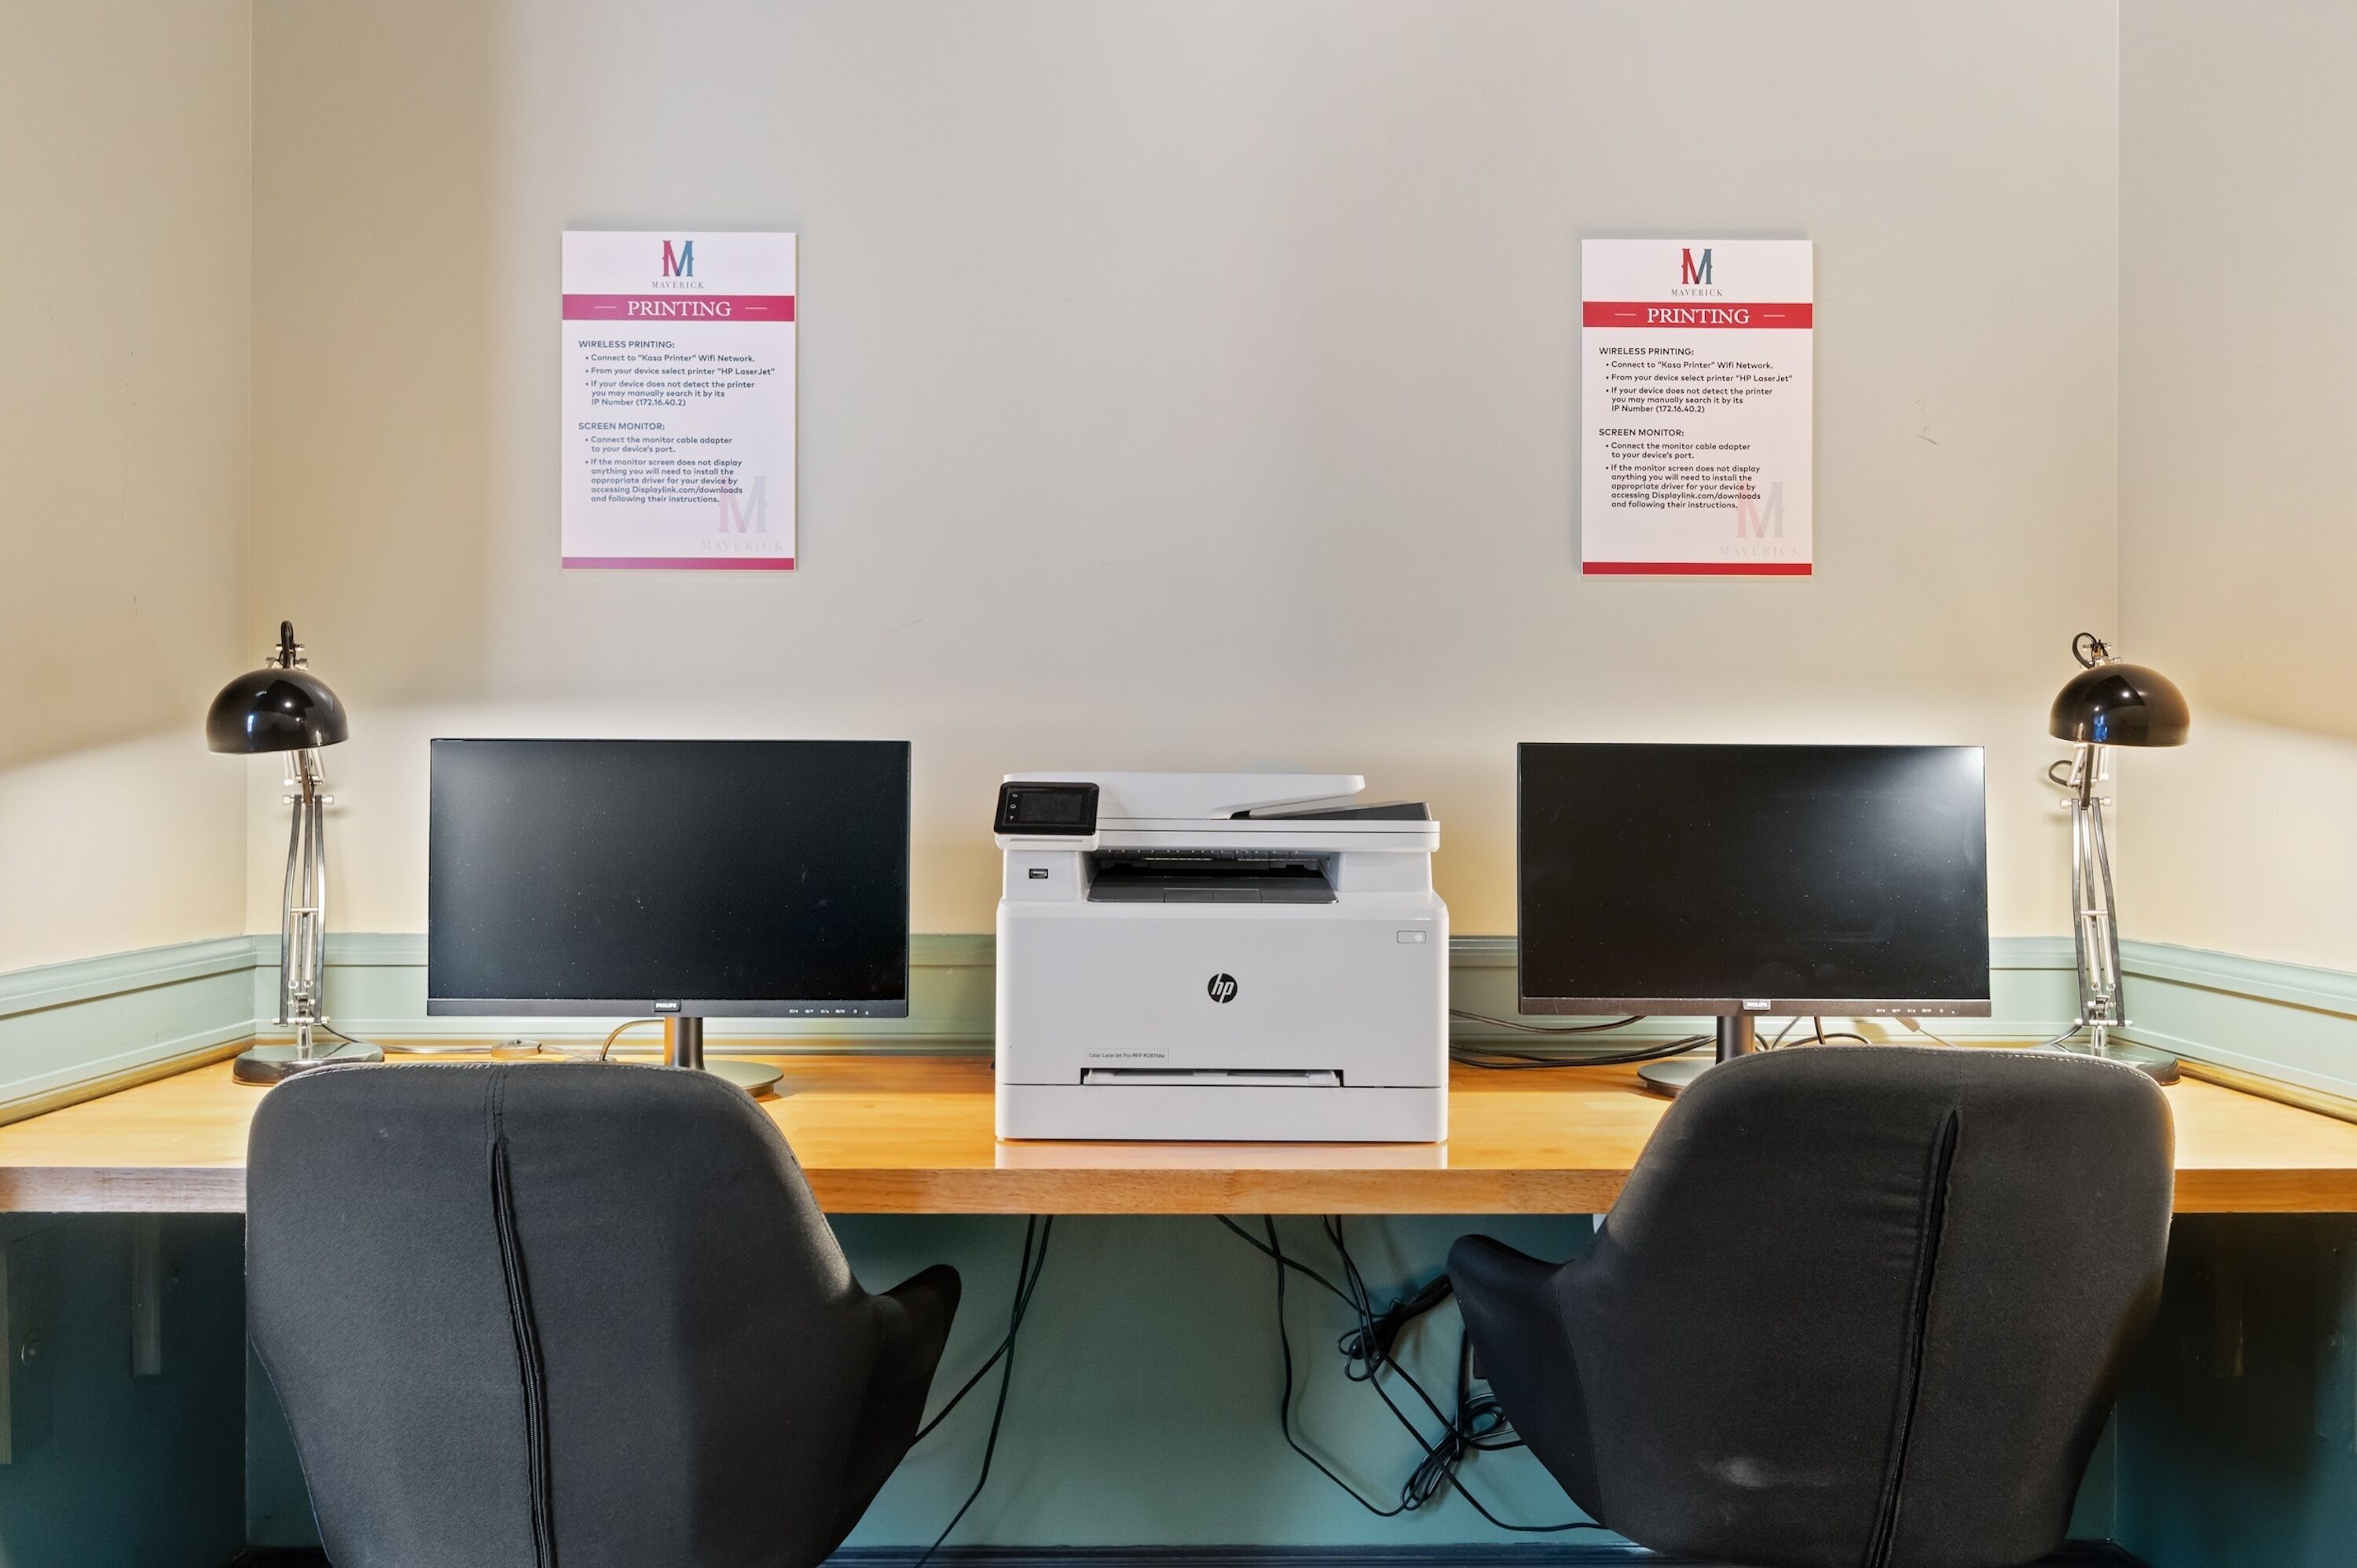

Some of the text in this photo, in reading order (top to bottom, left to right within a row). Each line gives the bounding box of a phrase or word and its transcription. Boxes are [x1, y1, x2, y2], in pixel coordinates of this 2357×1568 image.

[662, 240, 694, 277] M
[1681, 248, 1712, 284] M
[627, 301, 731, 317] PRINTING
[1647, 308, 1750, 324] PRINTING
[578, 340, 675, 349] WIRELESS PRINTING:
[1648, 347, 1694, 356] PRINTING:
[637, 354, 662, 362] "Kasa
[664, 354, 697, 362] Printer"
[698, 354, 716, 362] Wifi
[1683, 361, 1716, 369] Printer"
[591, 366, 613, 375] From
[661, 367, 686, 376] select
[687, 367, 716, 376] printer
[717, 367, 734, 376] "HP
[1653, 373, 1679, 382] device
[1706, 374, 1735, 383] printer
[618, 379, 644, 388] device
[646, 379, 665, 388] does
[727, 380, 755, 390] printer
[627, 389, 665, 398] manually
[665, 389, 693, 397] search
[694, 389, 702, 397] it
[702, 390, 713, 398] by
[714, 389, 725, 397] its
[1702, 387, 1728, 395] detect
[1745, 387, 1773, 396] printer
[636, 397, 687, 407] (172.16.40.2)
[1647, 395, 1684, 405] manually
[1721, 396, 1732, 405] by
[1732, 396, 1743, 405] its
[1655, 405, 1706, 414] (172.16.40.2)
[578, 422, 665, 430] SCREEN MONITOR:
[1638, 428, 1684, 437] MONITOR:
[626, 435, 641, 444] the
[642, 435, 675, 444] monitor
[676, 435, 698, 444] cable
[699, 436, 733, 445] adapter
[654, 445, 676, 454] port.
[1646, 441, 1660, 450] the
[1718, 442, 1751, 452] adapter
[1674, 452, 1695, 460] port.
[713, 458, 742, 467] display
[591, 467, 628, 477] anything
[629, 468, 644, 477] you
[720, 467, 735, 476] the
[1731, 464, 1761, 474] display
[591, 476, 640, 485] appropriate
[641, 476, 665, 485] driver
[666, 476, 680, 485] for
[700, 476, 727, 485] device
[728, 476, 739, 485] by
[1611, 473, 1647, 482] anything
[591, 485, 743, 495] accessing Displaylink.com/downloads
[1611, 482, 1659, 491] appropriate
[1746, 483, 1756, 492] by
[608, 494, 646, 504] following
[647, 494, 667, 503] their
[669, 494, 720, 503] instructions.
[1611, 491, 1761, 501] accessing Displaylink.com/downloads
[1611, 500, 1627, 508] and
[1628, 500, 1666, 510] following
[1688, 500, 1739, 509] instructions.
[701, 540, 783, 552] MAVERICK
[1720, 545, 1801, 557] MAVERICK
[1211, 973, 1234, 1003] hp
